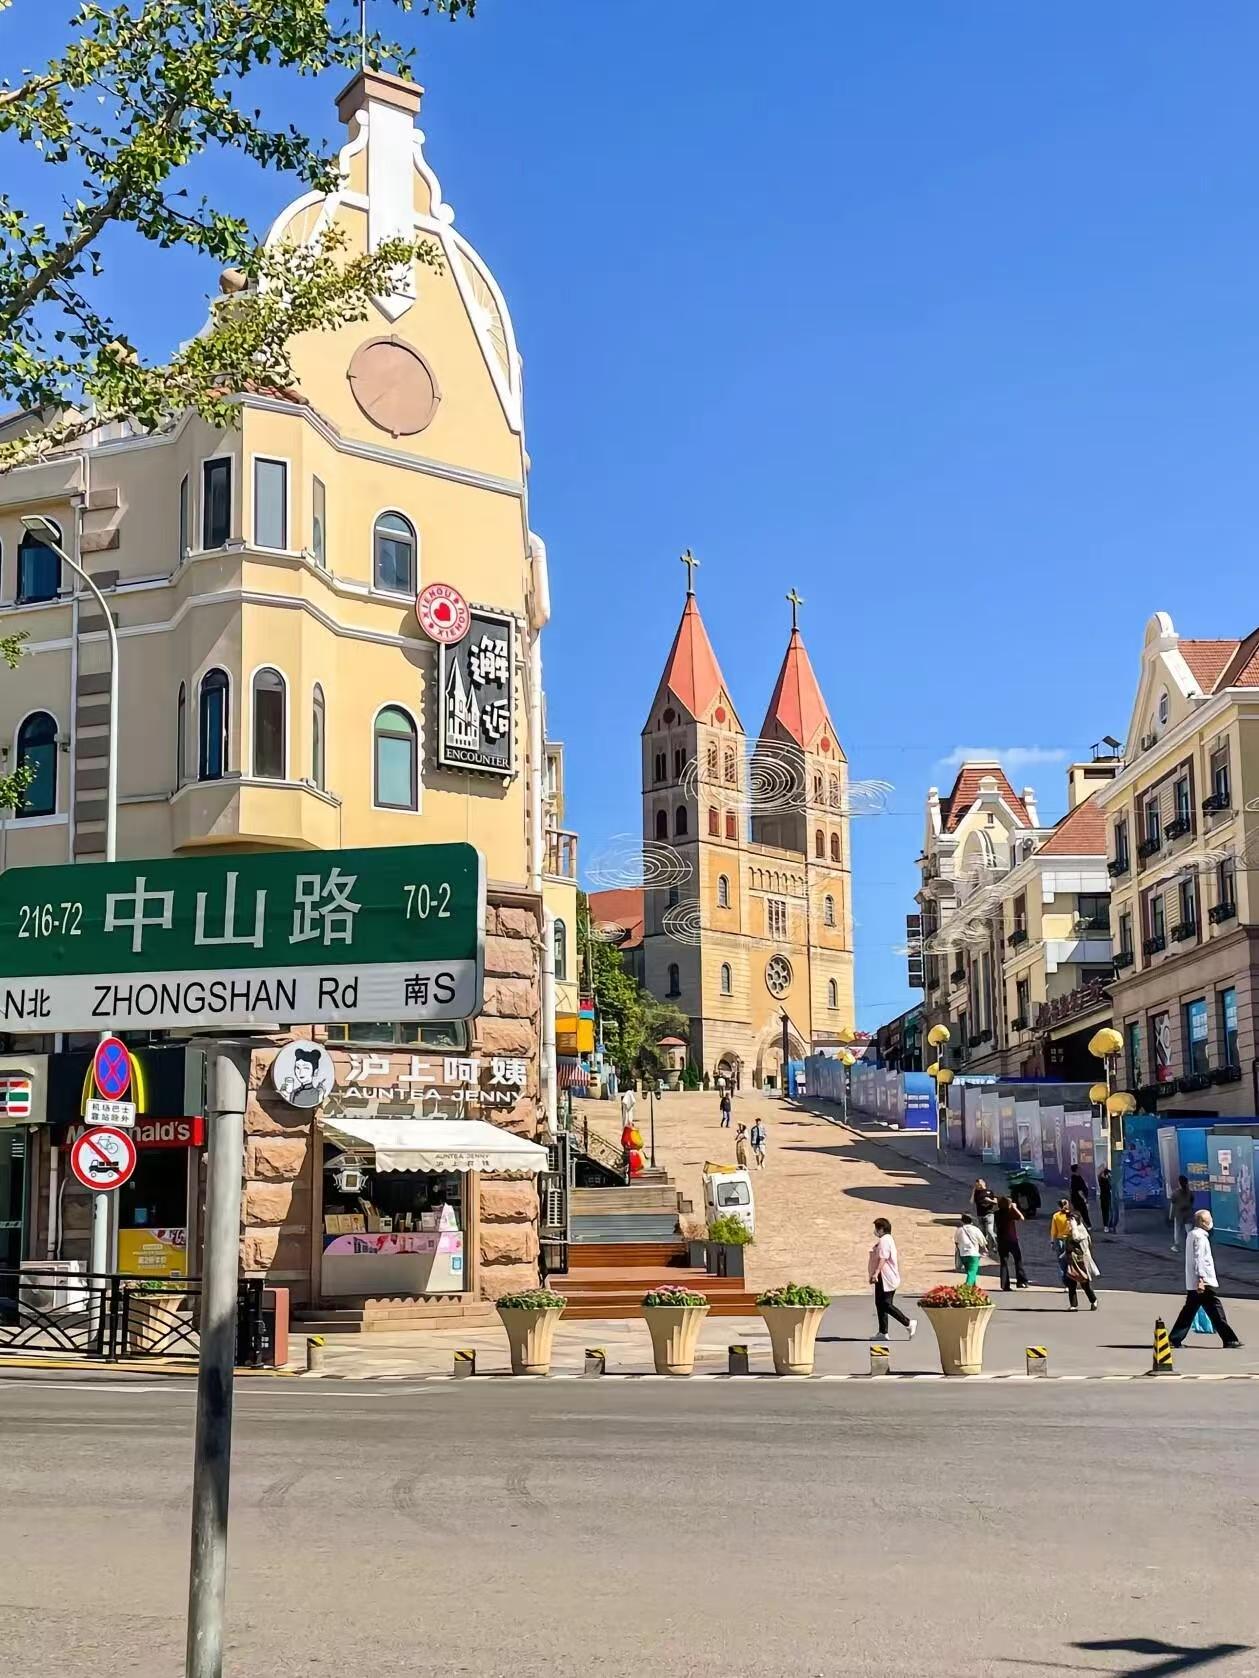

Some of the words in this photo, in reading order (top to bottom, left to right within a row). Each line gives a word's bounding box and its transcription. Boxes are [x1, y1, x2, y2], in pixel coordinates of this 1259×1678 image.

[469, 634, 510, 739] 邂逅
[445, 749, 509, 767] ENCOUNTER
[18, 902, 83, 938] 216-72
[103, 867, 362, 953] 中山路
[403, 882, 451, 919] 70-2
[4, 988, 51, 1019] N北
[91, 978, 296, 1017] ZHONGSHAN
[318, 976, 358, 1009] Rd
[403, 972, 456, 1006] 南S
[345, 1052, 528, 1085] 沪上阿姨
[344, 1087, 442, 1101] AUNTEA
[451, 1089, 526, 1102] JENNY
